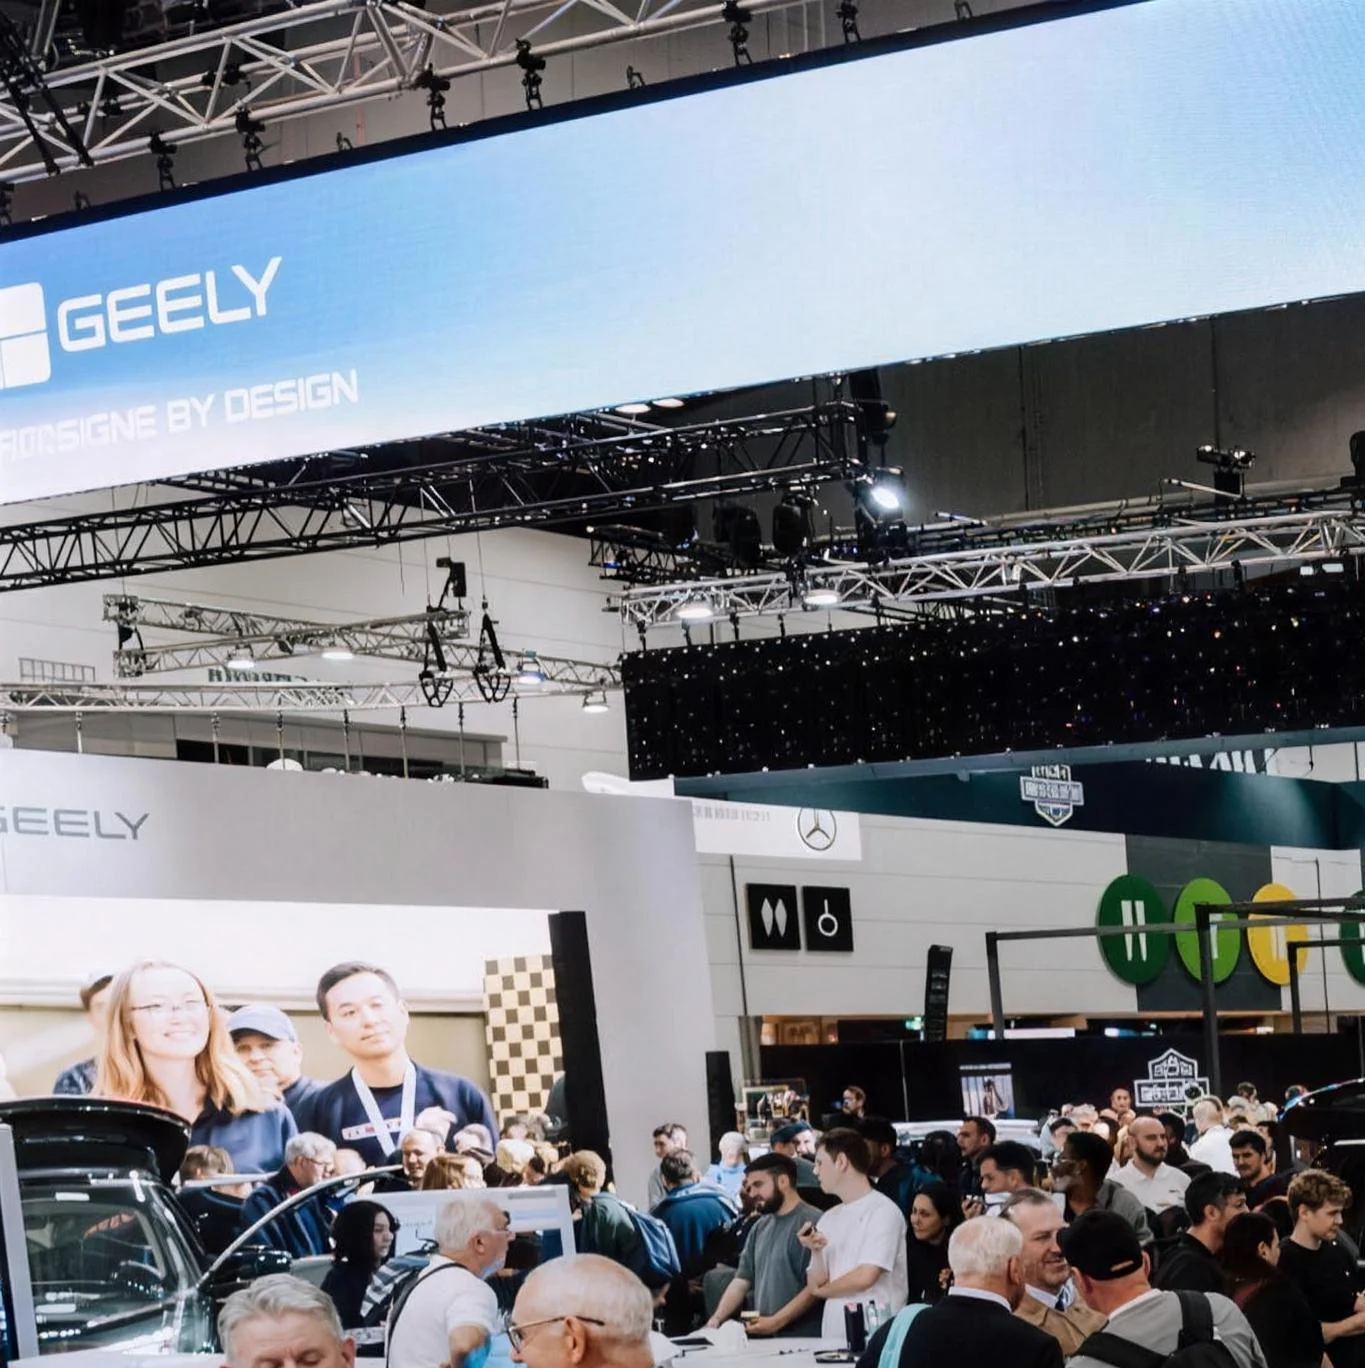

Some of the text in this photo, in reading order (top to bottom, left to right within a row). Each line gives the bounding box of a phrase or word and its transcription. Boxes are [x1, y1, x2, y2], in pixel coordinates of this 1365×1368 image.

[57, 256, 282, 352] GEELY
[167, 393, 215, 434] BY
[224, 368, 359, 424] DESIGN
